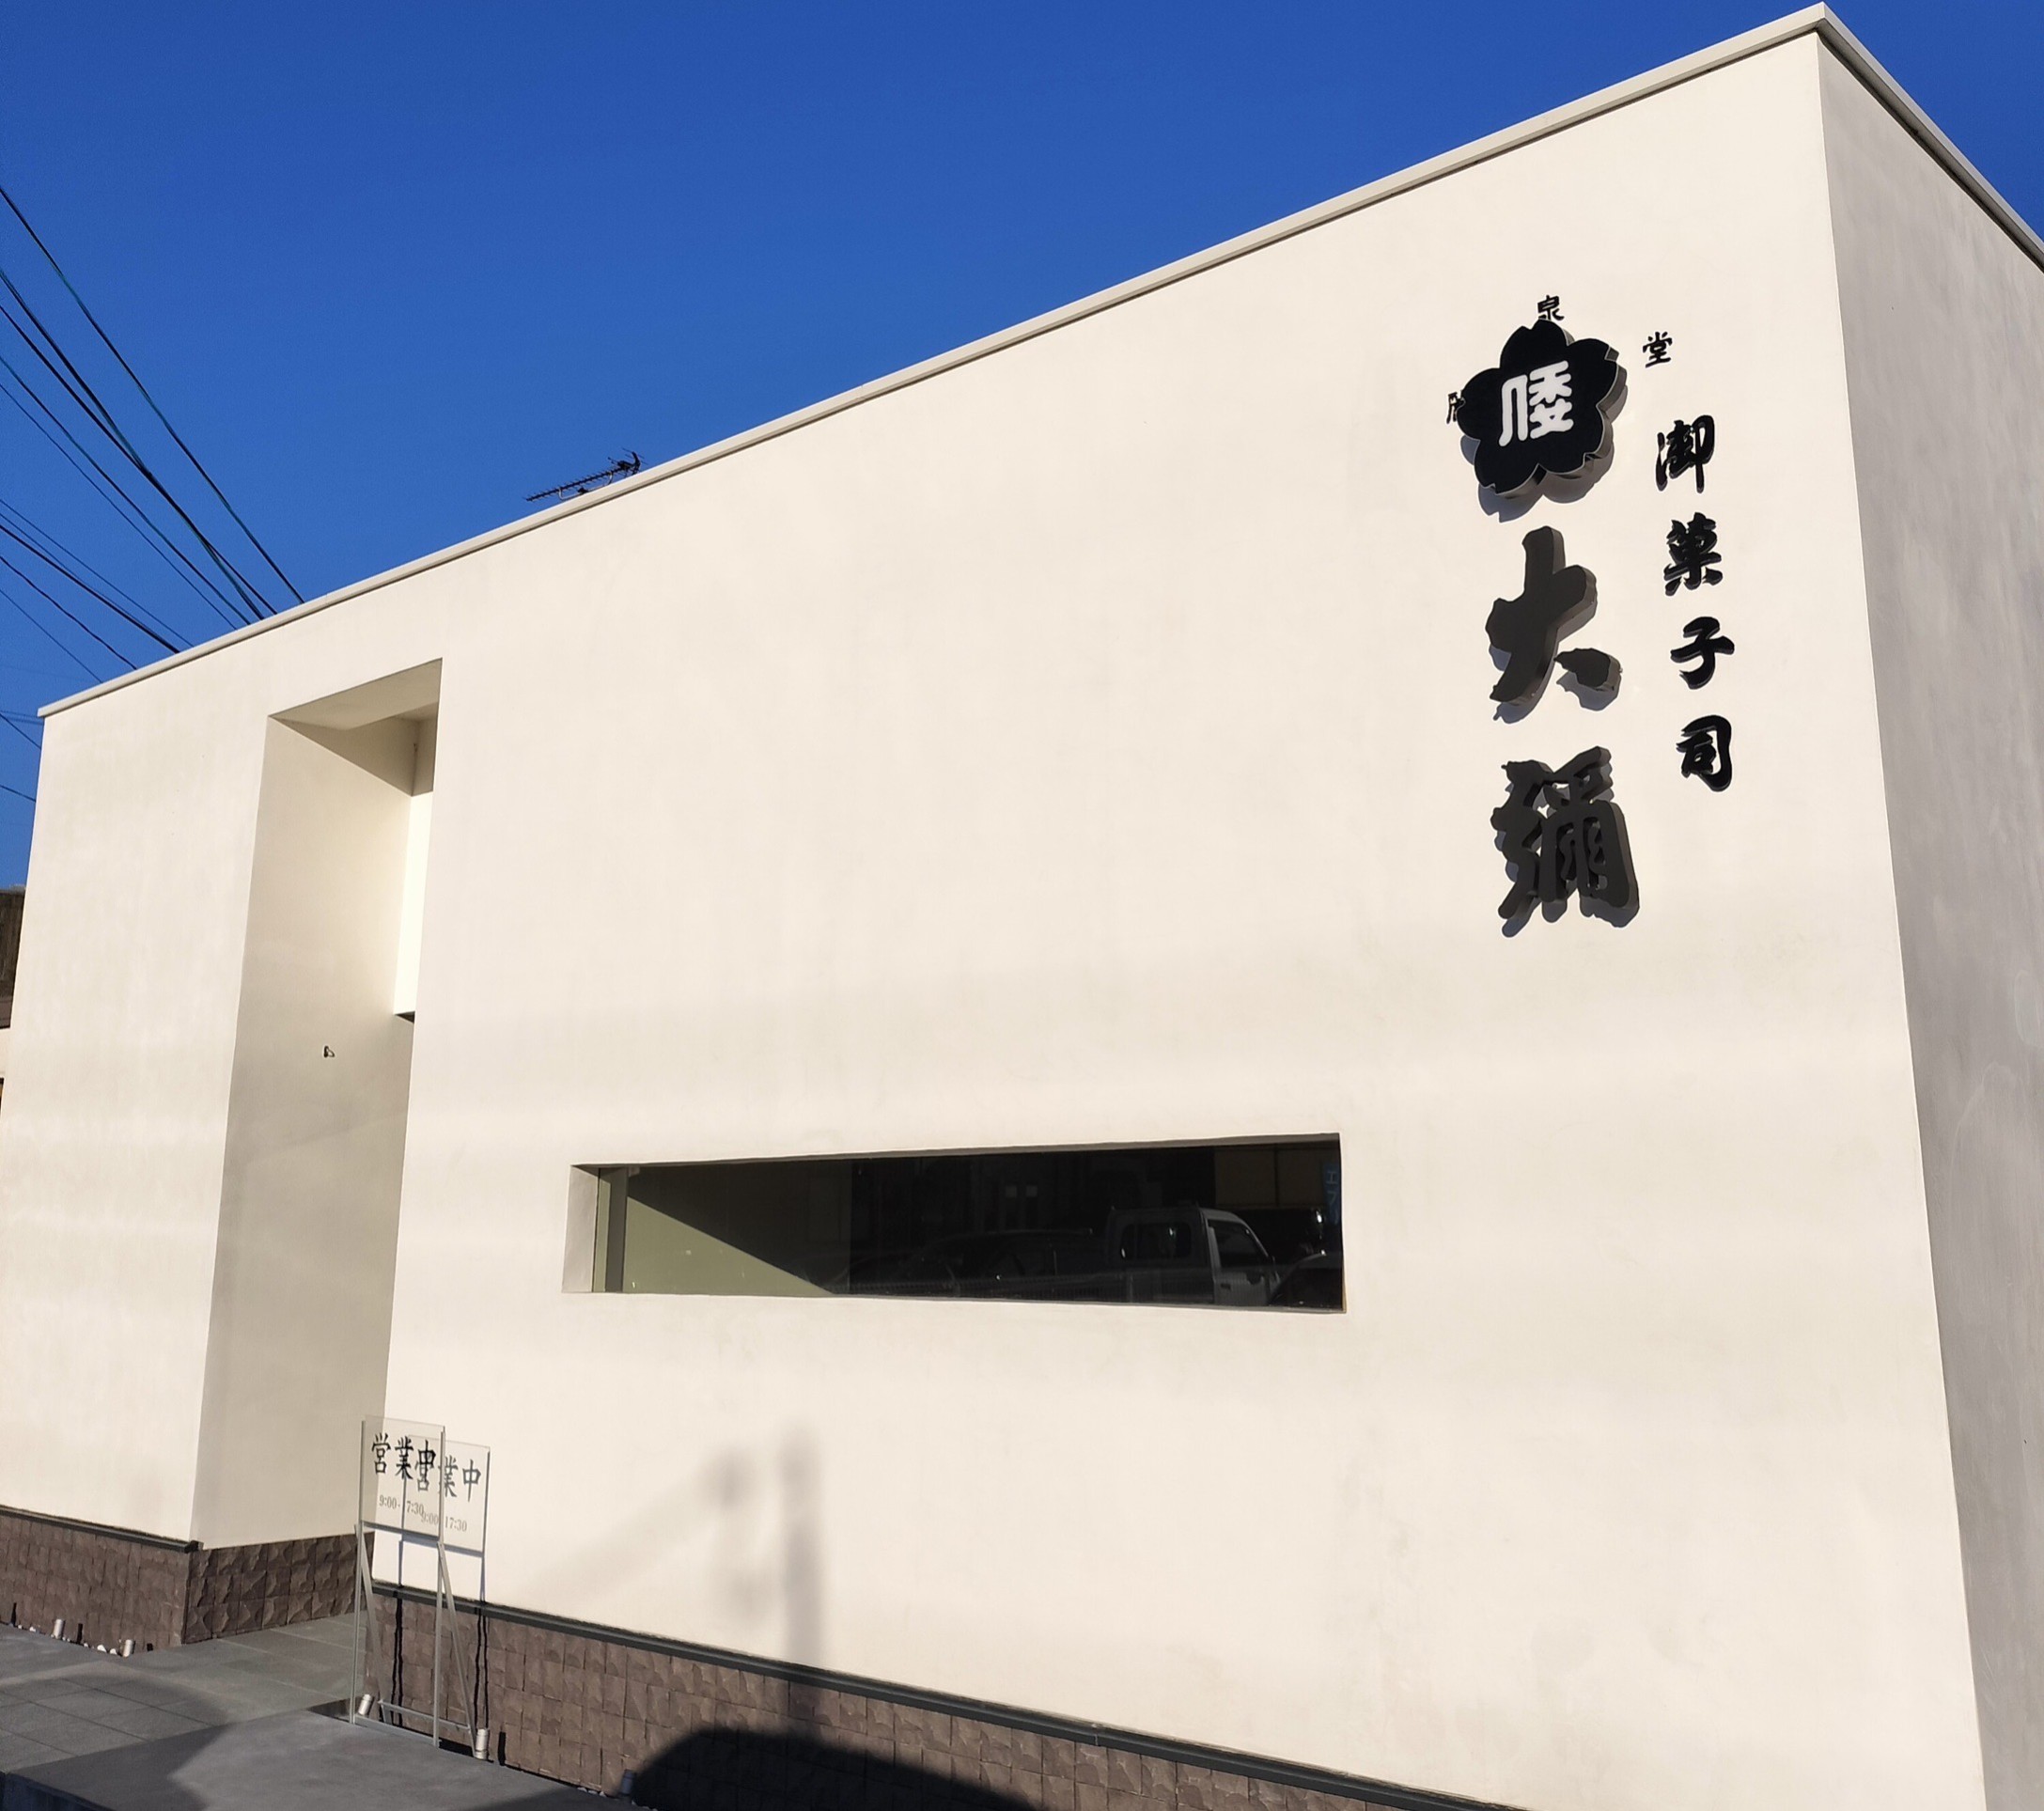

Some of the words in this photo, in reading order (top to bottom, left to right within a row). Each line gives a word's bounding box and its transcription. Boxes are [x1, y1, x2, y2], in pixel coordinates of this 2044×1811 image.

[1537, 294, 1565, 321] 泉
[1643, 332, 1673, 367] 堂
[1655, 414, 1736, 792] 御菓子司
[371, 1432, 436, 1483] 営業中
